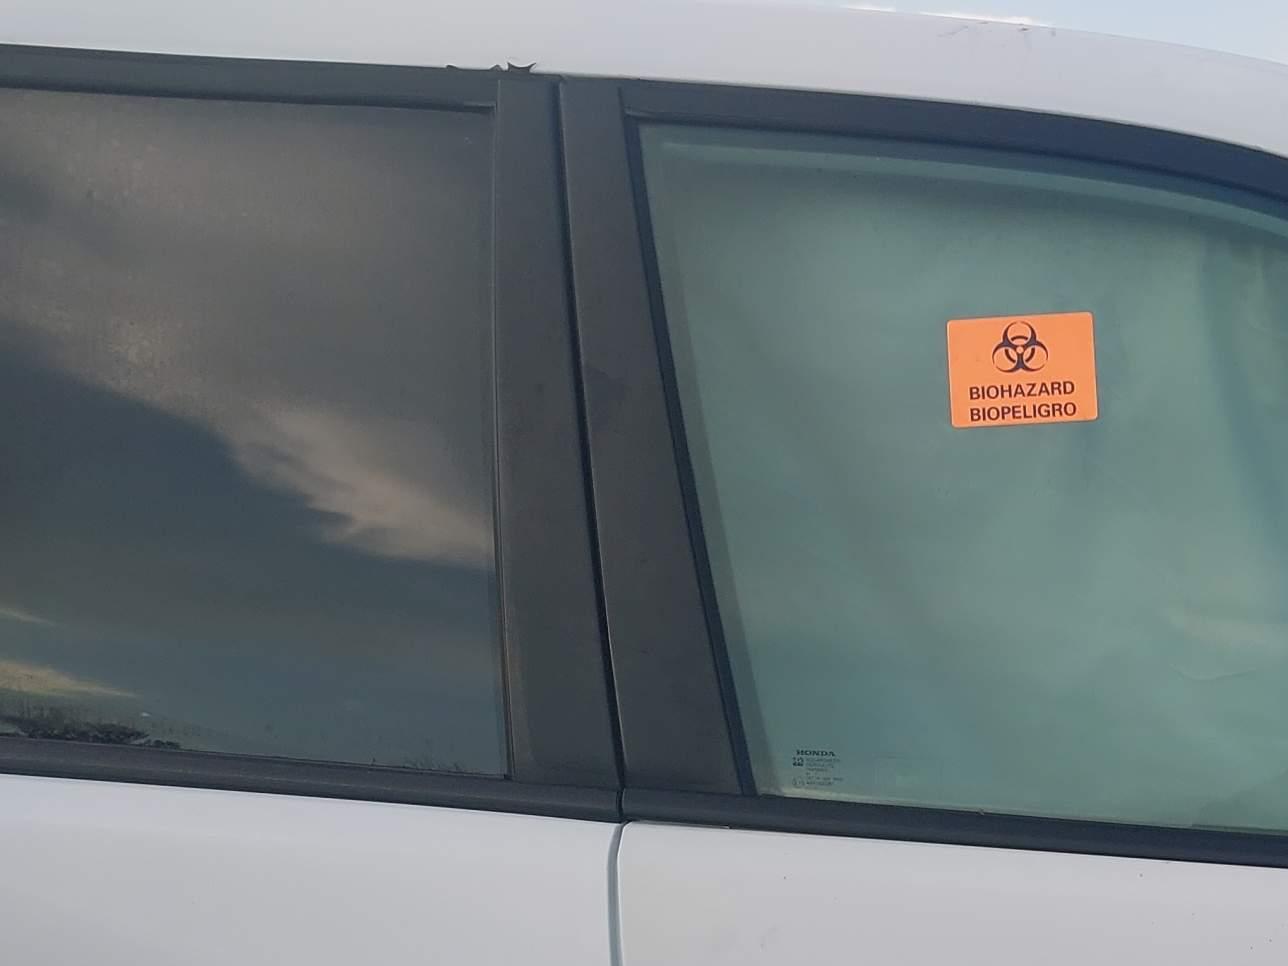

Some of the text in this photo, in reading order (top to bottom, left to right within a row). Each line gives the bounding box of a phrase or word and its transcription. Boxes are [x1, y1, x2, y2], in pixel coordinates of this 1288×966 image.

[969, 381, 1075, 399] BIOHAZARD
[970, 402, 1077, 421] BIOPELIGRO
[796, 749, 835, 757] HONDA
